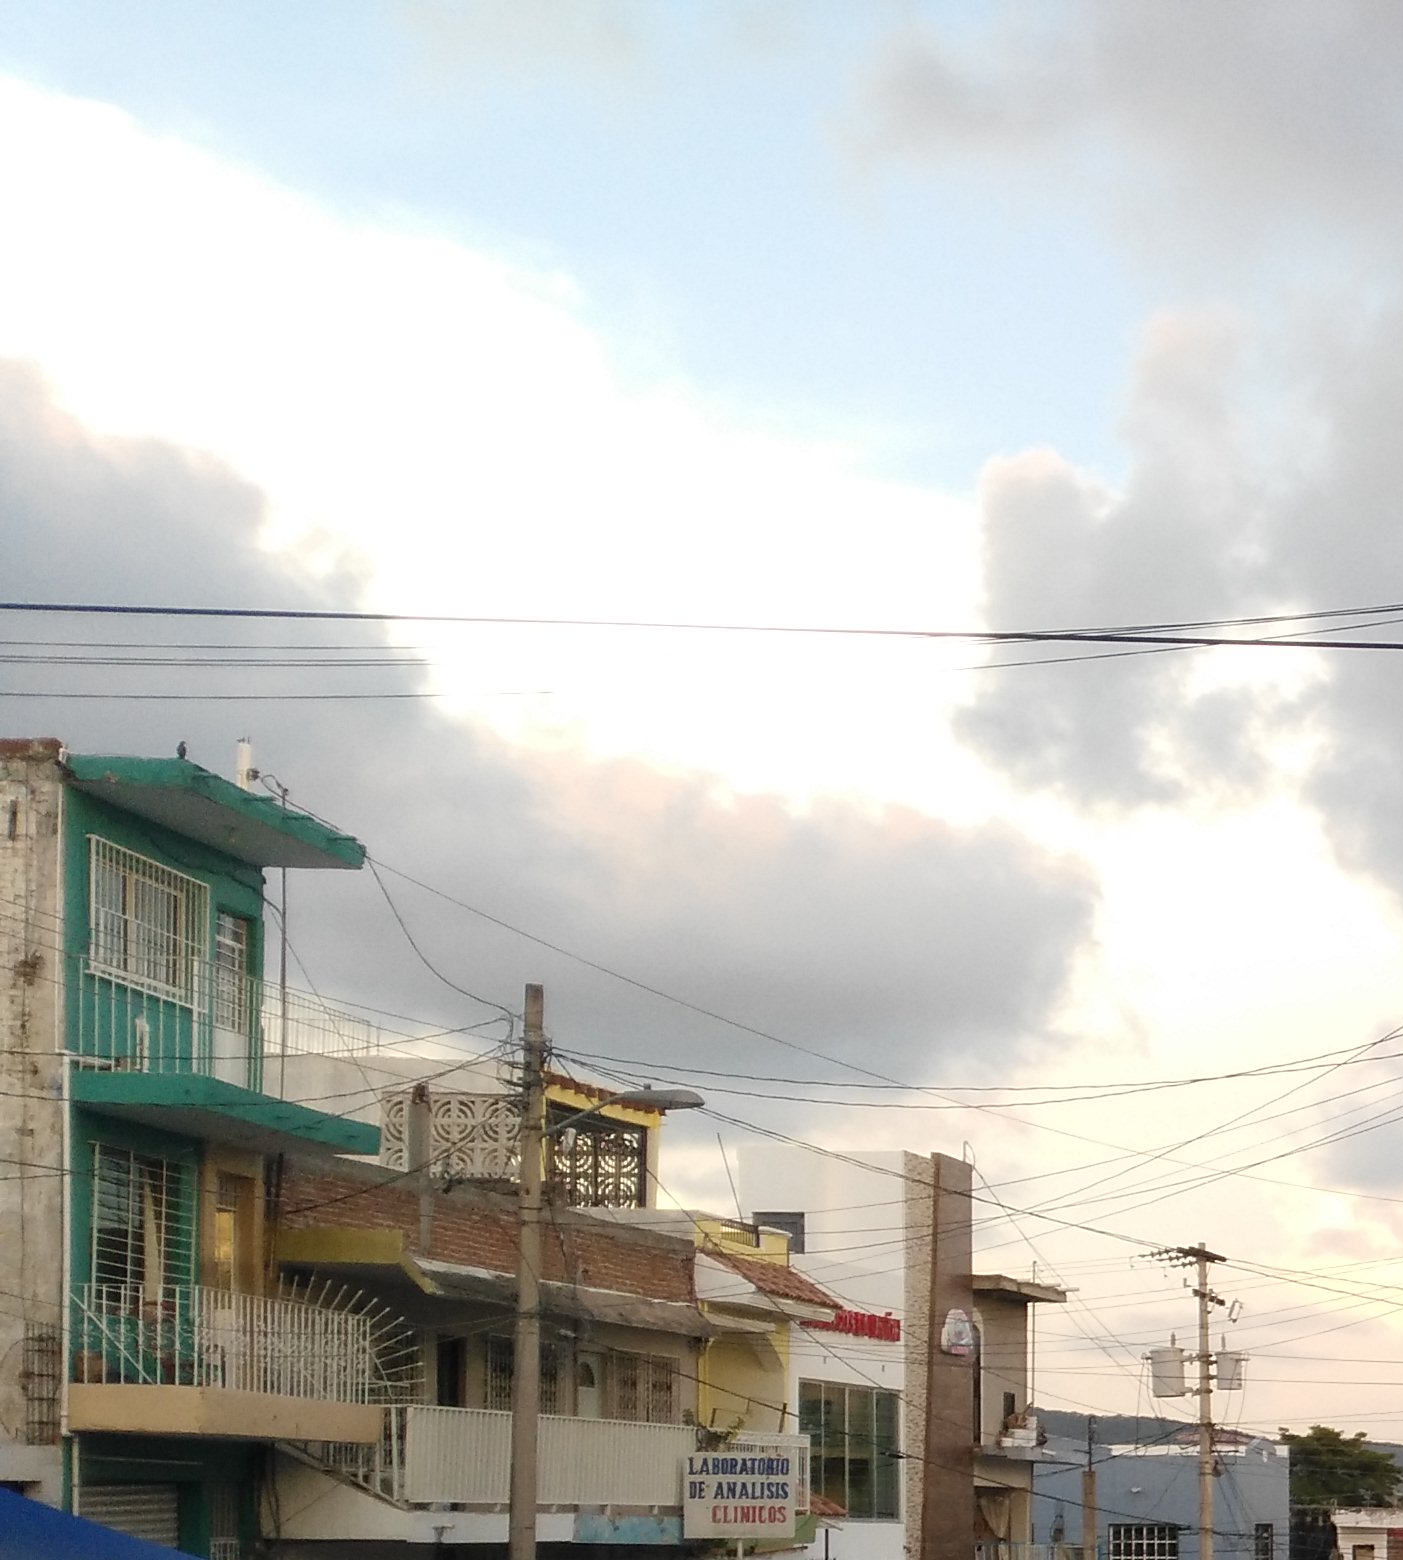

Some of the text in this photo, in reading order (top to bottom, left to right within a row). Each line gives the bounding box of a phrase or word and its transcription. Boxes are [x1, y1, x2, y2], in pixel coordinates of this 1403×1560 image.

[688, 1457, 789, 1475] LABORATORIO
[689, 1481, 789, 1499] DE ANALISIS
[712, 1505, 786, 1523] CLINICOS
